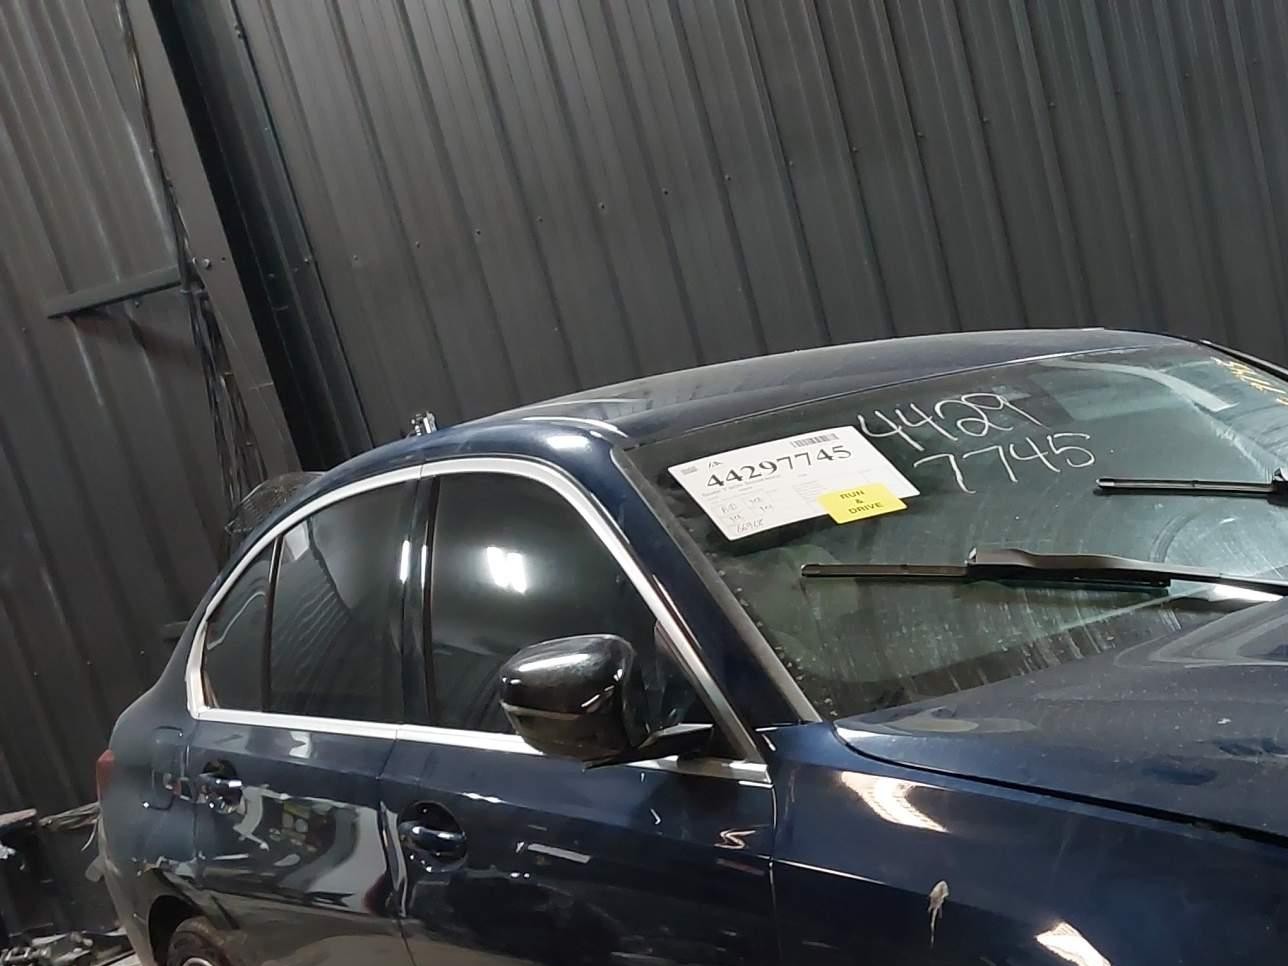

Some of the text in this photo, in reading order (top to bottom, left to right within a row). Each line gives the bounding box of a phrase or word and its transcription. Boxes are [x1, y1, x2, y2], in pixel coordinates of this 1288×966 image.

[857, 392, 1048, 452] 4429
[706, 445, 852, 488] 44297745
[913, 432, 1096, 495] 7745
[840, 489, 865, 500] RUN
[849, 502, 884, 514] DRIVE
